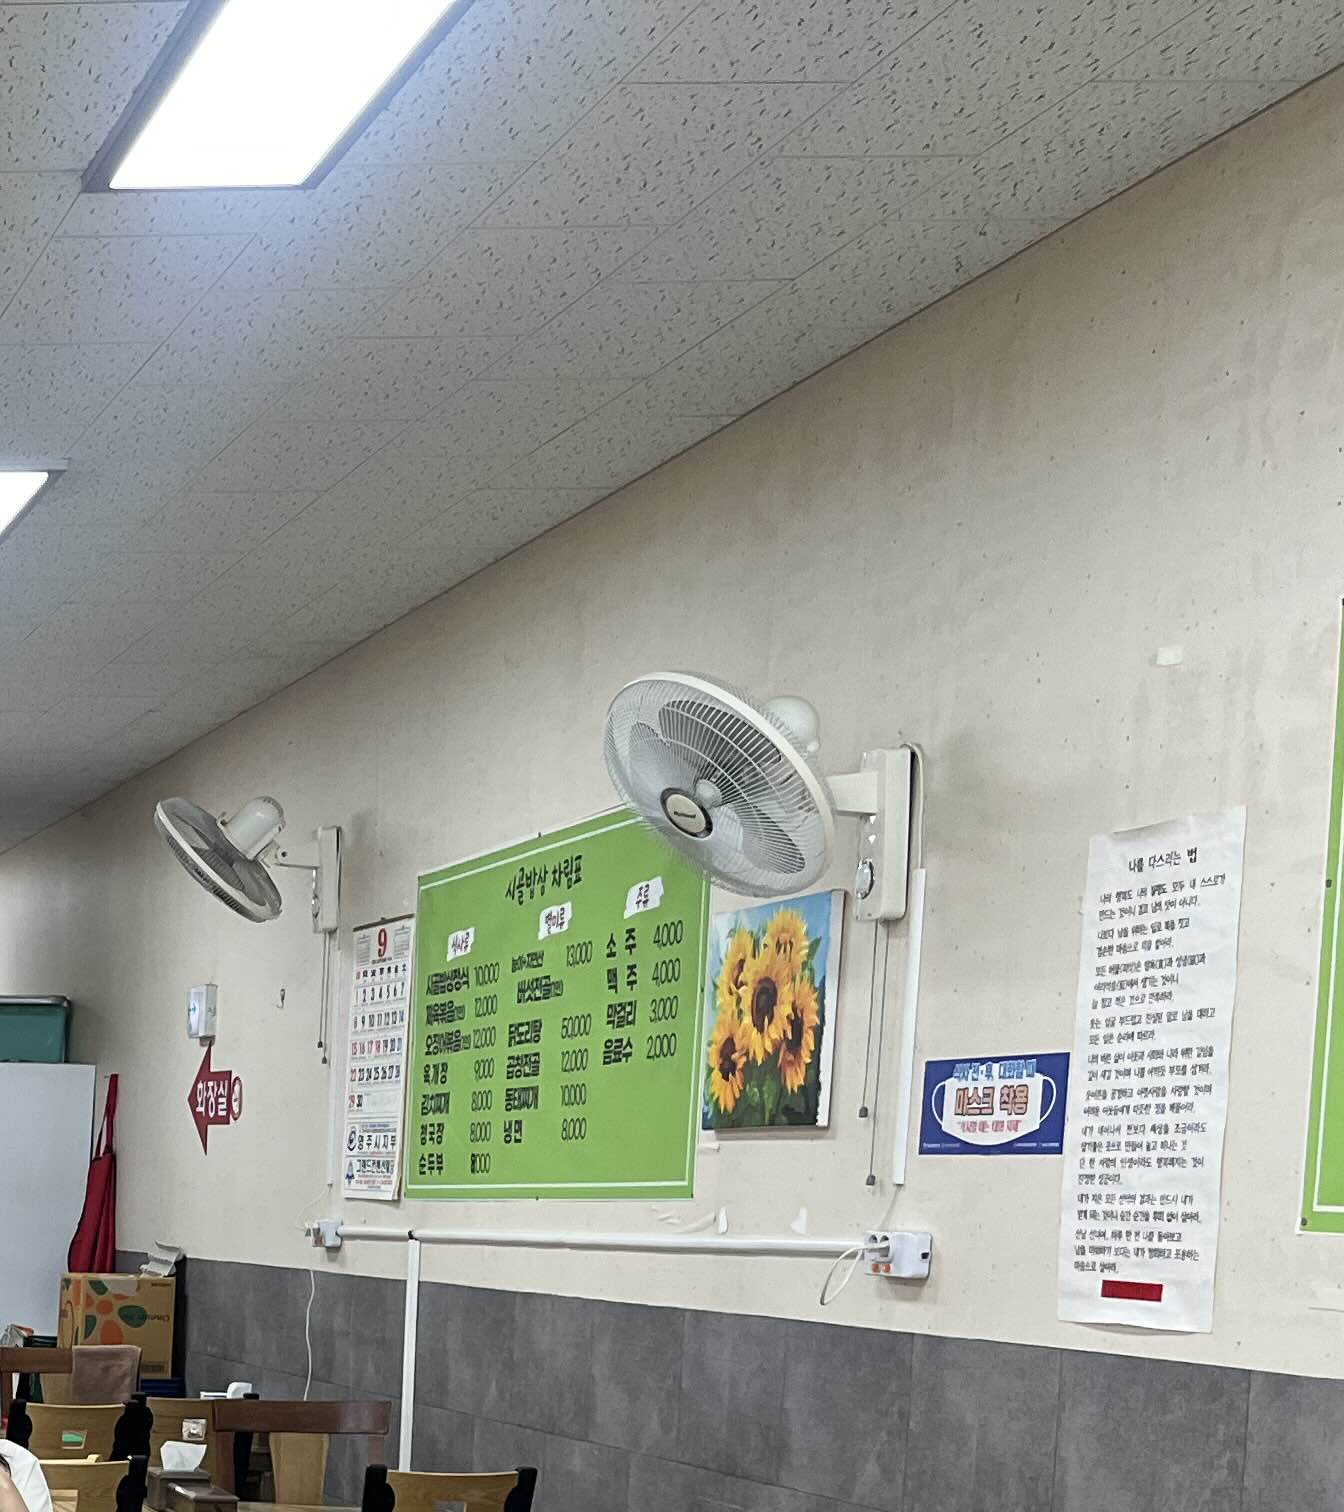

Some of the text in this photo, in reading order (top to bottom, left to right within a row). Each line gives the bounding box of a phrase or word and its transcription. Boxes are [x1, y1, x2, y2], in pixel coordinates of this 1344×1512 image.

[1187, 847, 1197, 863] 법
[505, 854, 583, 905] 시골밥상 차림표
[378, 928, 387, 957] 9
[606, 920, 683, 958] 소 주 4,000
[566, 940, 592, 968] 13,000
[626, 964, 637, 991] 주
[652, 958, 681, 988] 4,000
[561, 1013, 592, 1040] 50,000
[606, 995, 679, 1029] 막걸리 3,000
[561, 1048, 589, 1073] 12,000
[603, 1032, 677, 1066] 음료수 2,000
[196, 1080, 228, 1118] 화장실
[561, 1083, 587, 1107] 10,000
[954, 1084, 1029, 1116] 마스크 착용
[562, 1117, 587, 1141] 8,000
[419, 1153, 443, 1175] 순두부
